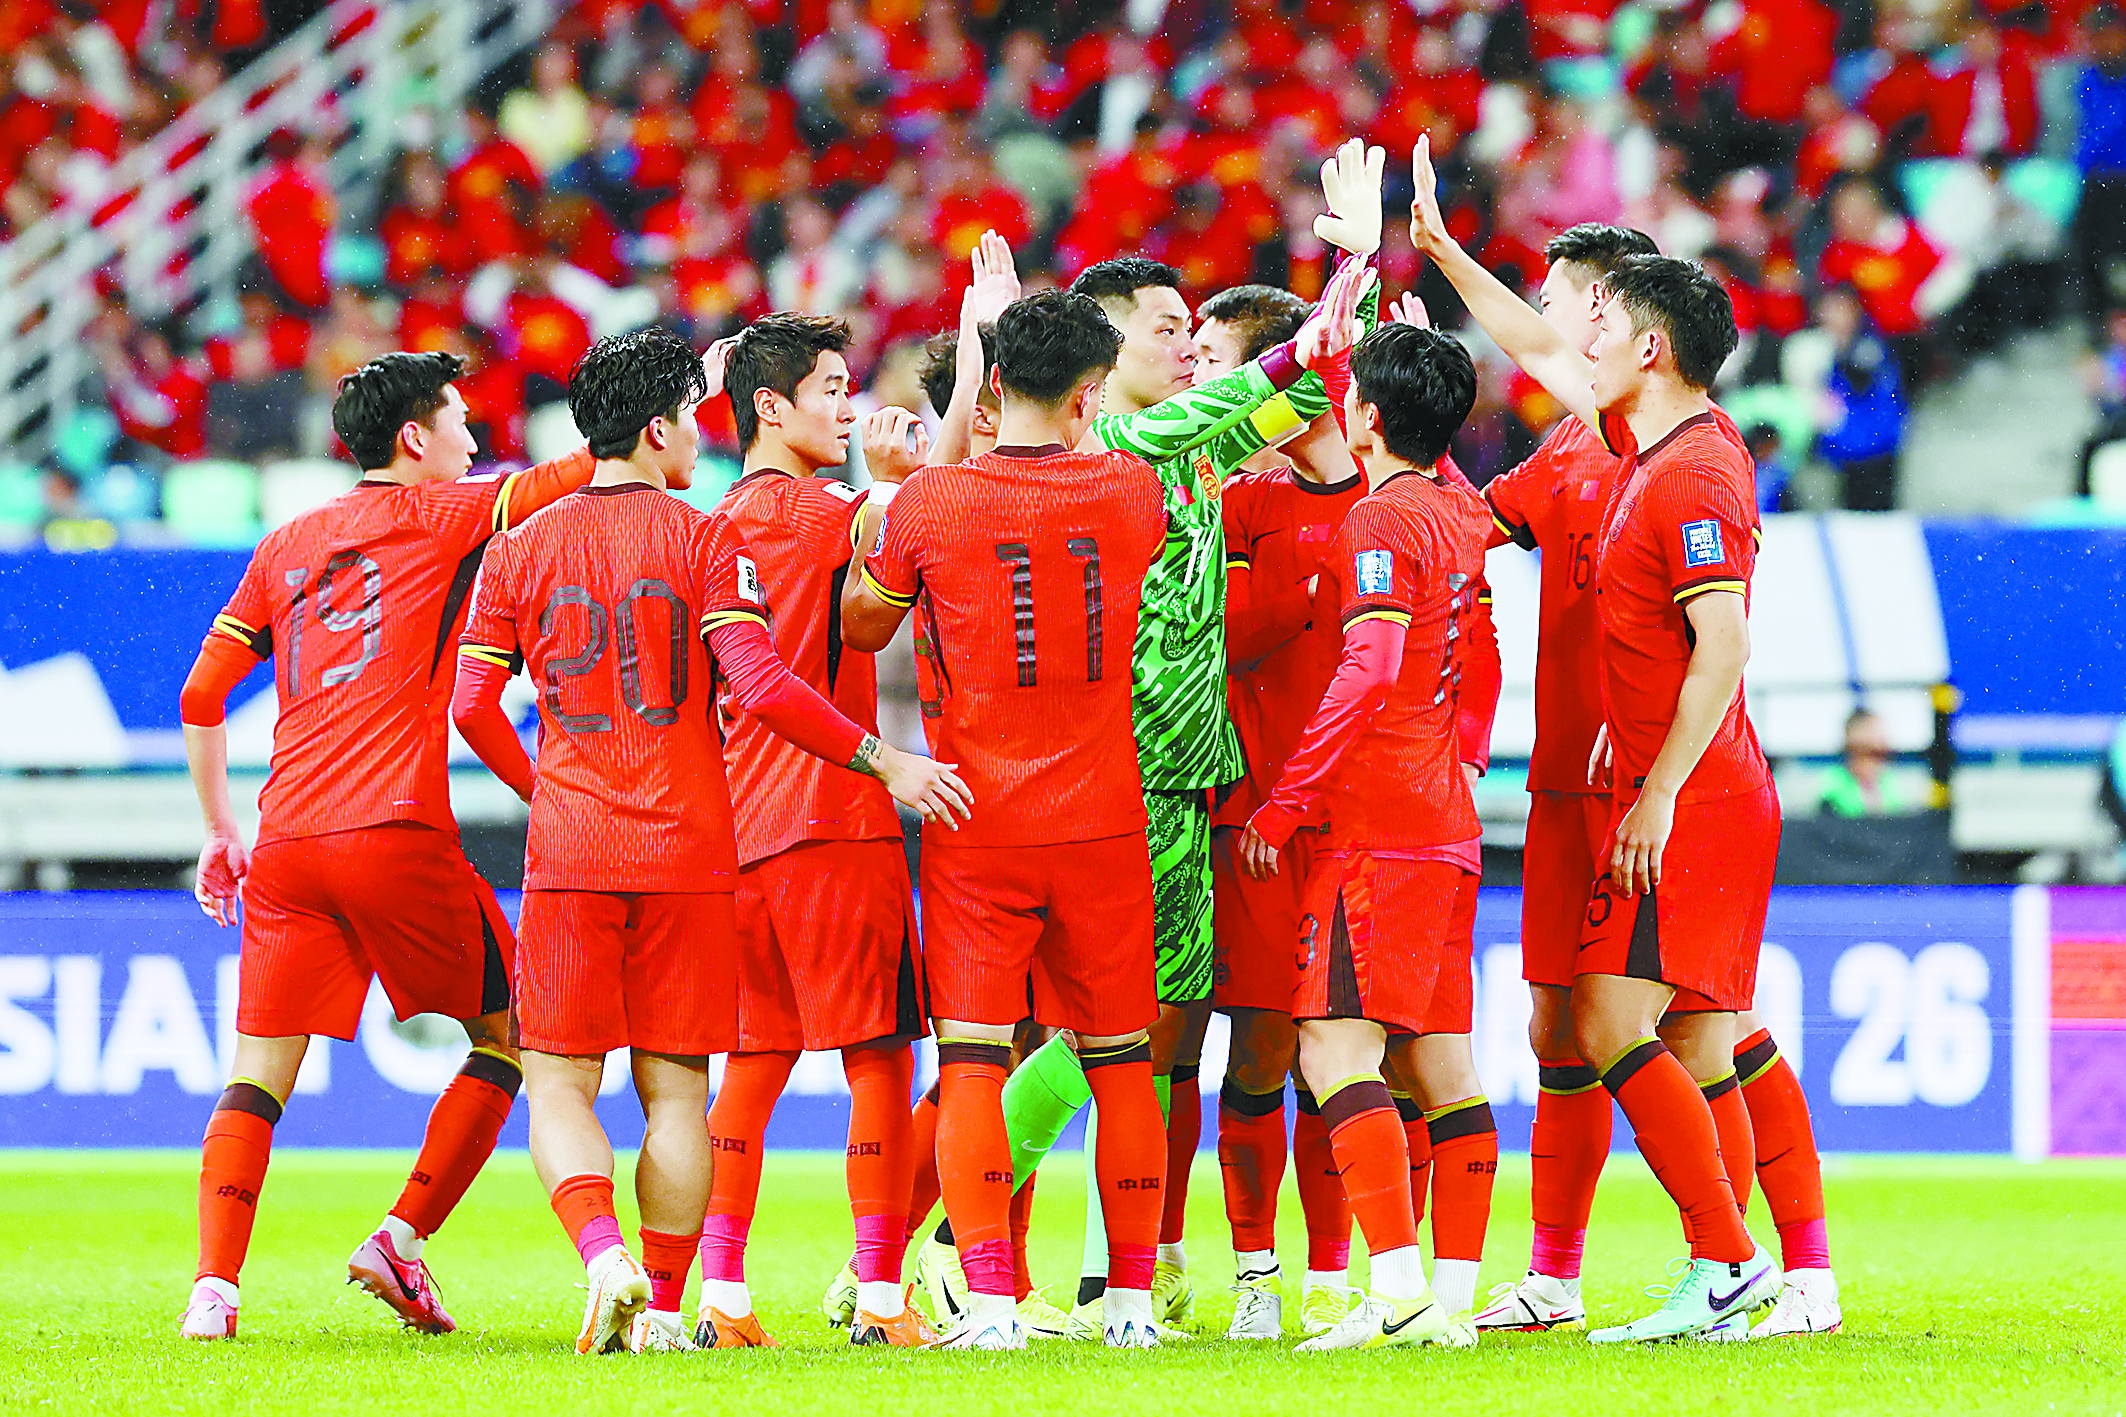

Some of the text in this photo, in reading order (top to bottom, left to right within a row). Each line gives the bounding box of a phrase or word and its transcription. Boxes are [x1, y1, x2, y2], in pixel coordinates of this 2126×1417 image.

[995, 537, 1102, 687] 11
[1565, 532, 1593, 590] 16
[284, 549, 382, 698] 19
[538, 578, 689, 733] 20
[1295, 912, 1319, 971] 3
[1829, 942, 1992, 1107] 26
[216, 1184, 256, 1207] 中国
[1117, 1177, 1160, 1191] 中国
